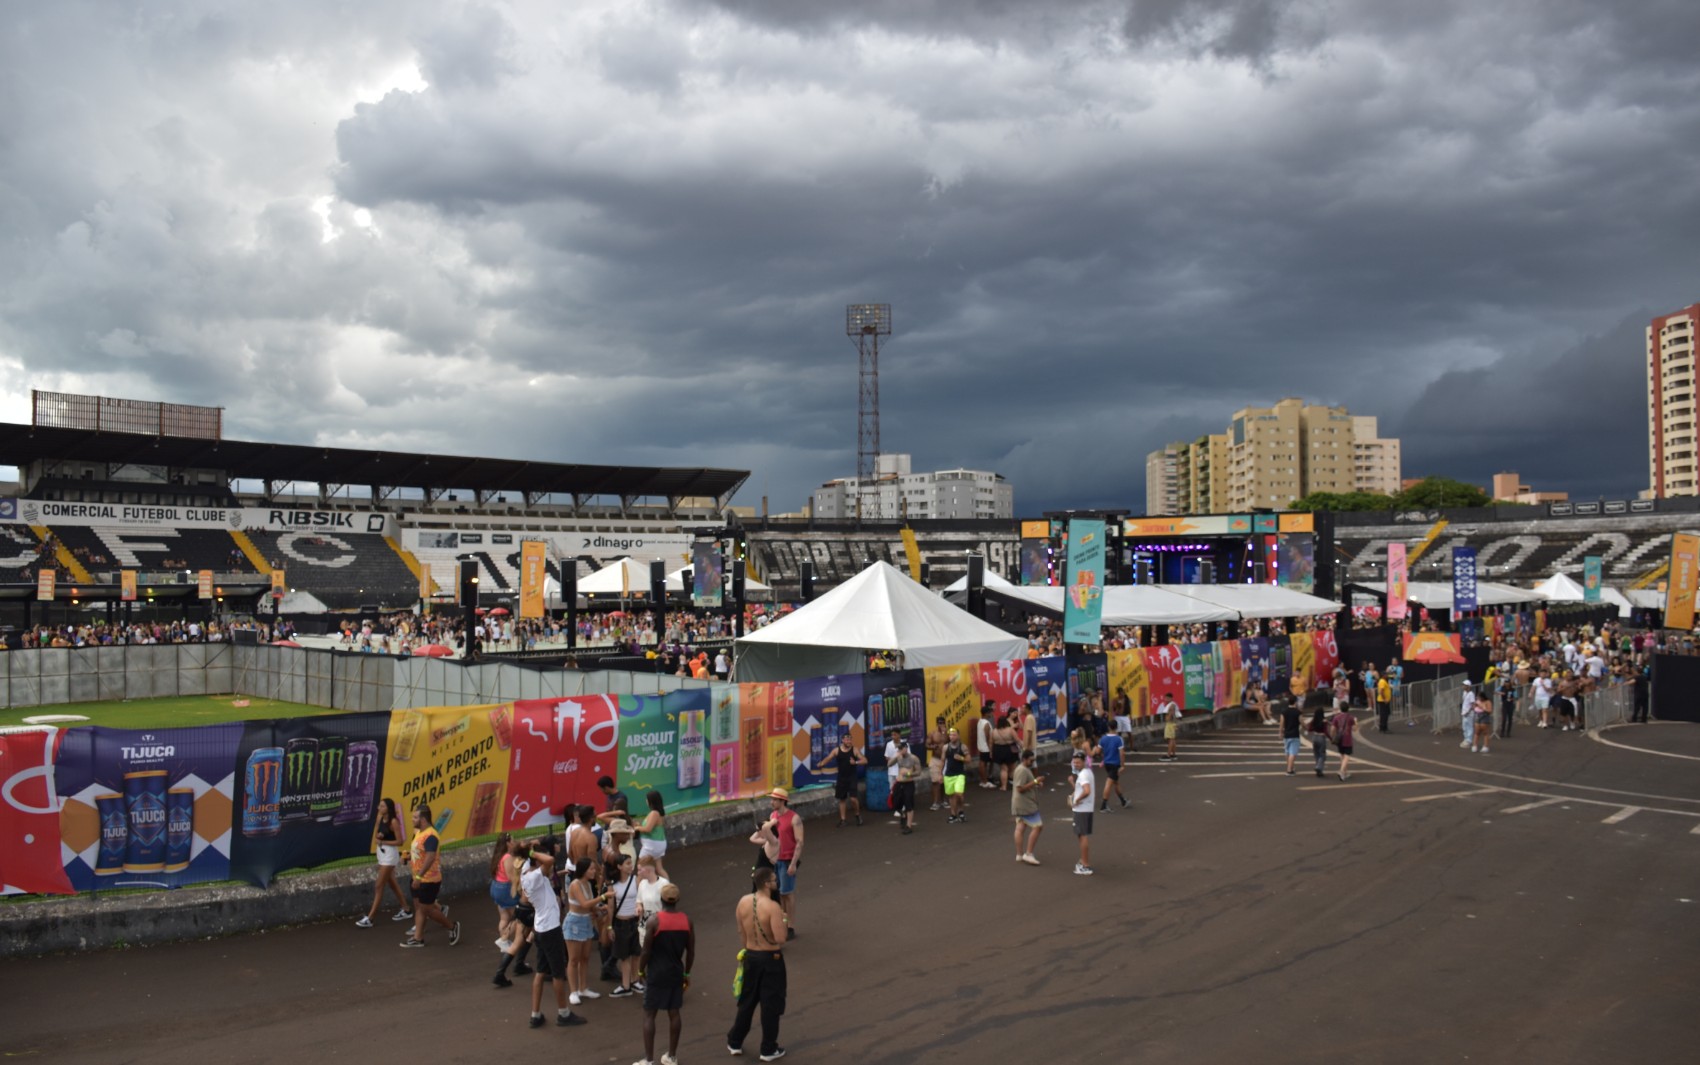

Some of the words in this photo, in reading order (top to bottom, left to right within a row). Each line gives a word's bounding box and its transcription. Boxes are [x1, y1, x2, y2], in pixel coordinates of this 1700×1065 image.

[42, 503, 117, 518] COMERCIAL
[123, 507, 181, 520] FUTEBOL
[186, 509, 226, 521] CLUBE
[269, 510, 353, 528] RIBSIK
[593, 536, 643, 550] dinagro
[625, 730, 677, 748] ABSOLUT
[121, 745, 175, 760] TIJUCA
[403, 764, 443, 797] DRINK
[446, 735, 494, 774] PRONTO
[624, 750, 674, 776] Sprite
[410, 782, 445, 812] PARA
[449, 757, 491, 791] BEBER.
[131, 809, 165, 824] TIJUCA
[248, 803, 280, 814] JUICE
